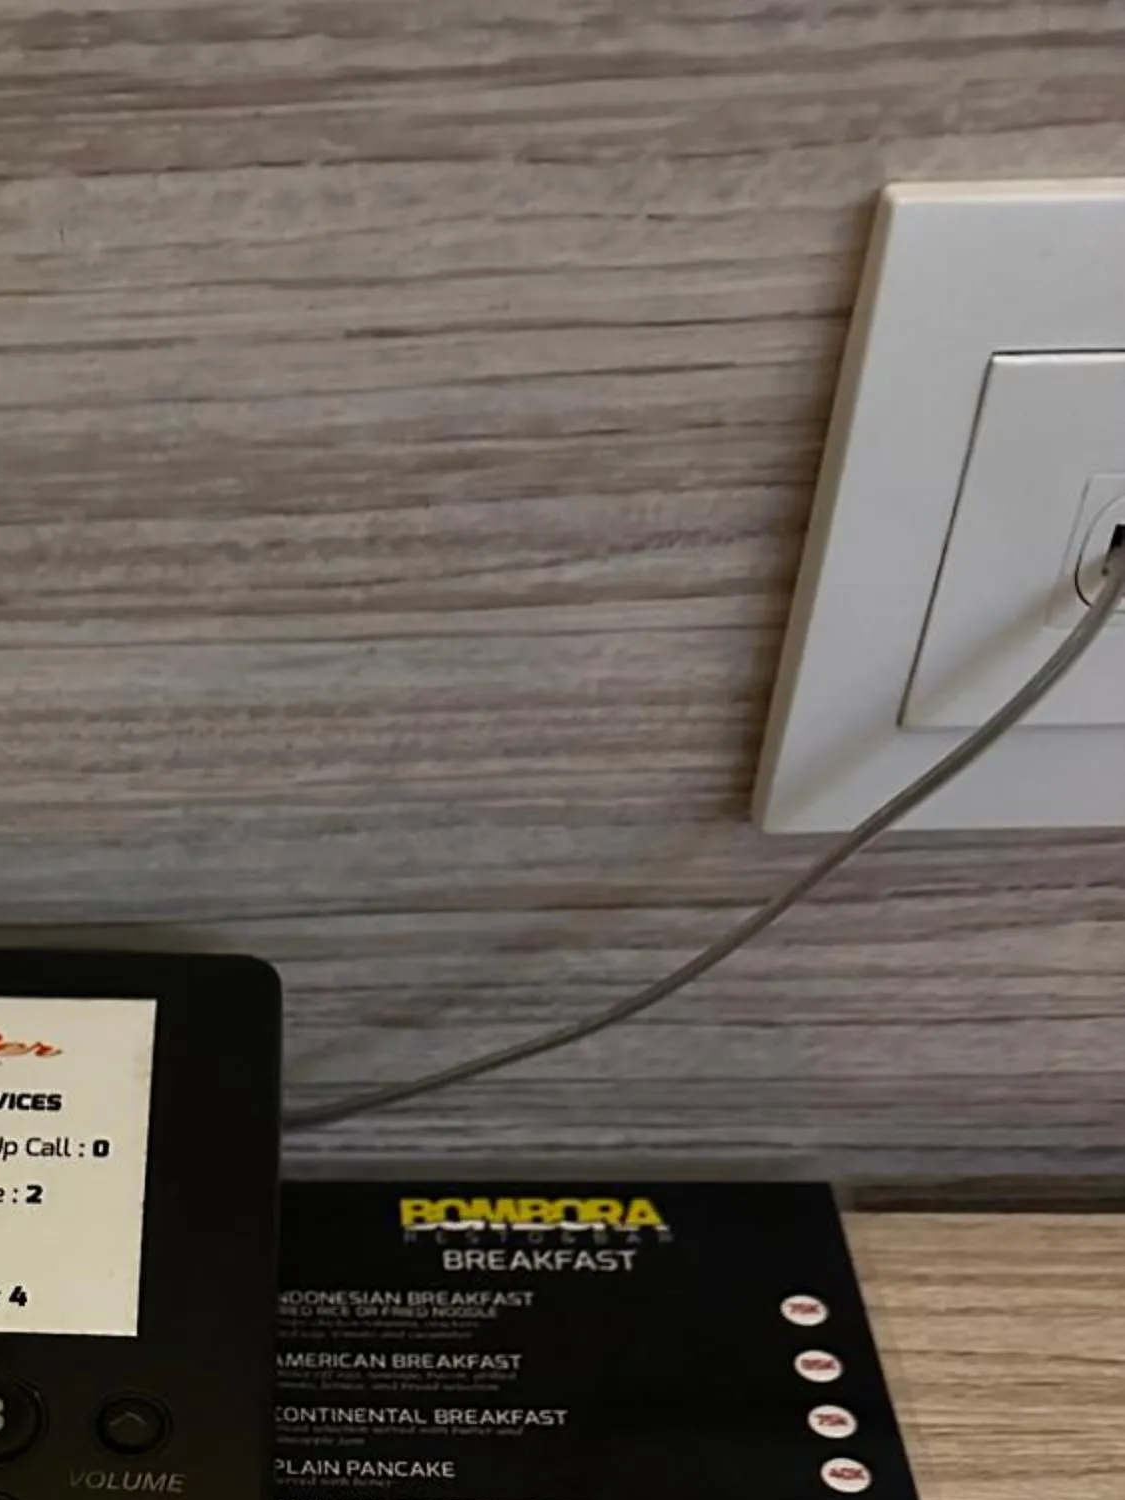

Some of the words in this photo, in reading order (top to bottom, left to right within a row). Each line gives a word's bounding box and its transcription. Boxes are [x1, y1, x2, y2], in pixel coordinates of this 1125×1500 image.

[26, 1138, 71, 1157] Call
[92, 1140, 109, 1158] 0
[25, 1185, 43, 1203] 2
[400, 1197, 664, 1229] BOMBORA
[443, 1249, 637, 1271] BREAKFAST
[8, 1286, 27, 1306] 4
[278, 1290, 401, 1306] NDONESIAN
[407, 1291, 534, 1308] BREAKFAST
[276, 1352, 386, 1369] AMERICAN
[391, 1353, 523, 1370] BREAKFAST
[434, 1408, 569, 1426] BREAKFAST
[275, 1459, 339, 1476] PLAIN
[345, 1459, 456, 1478] PANCAKE
[69, 1471, 188, 1494] VOLUME
